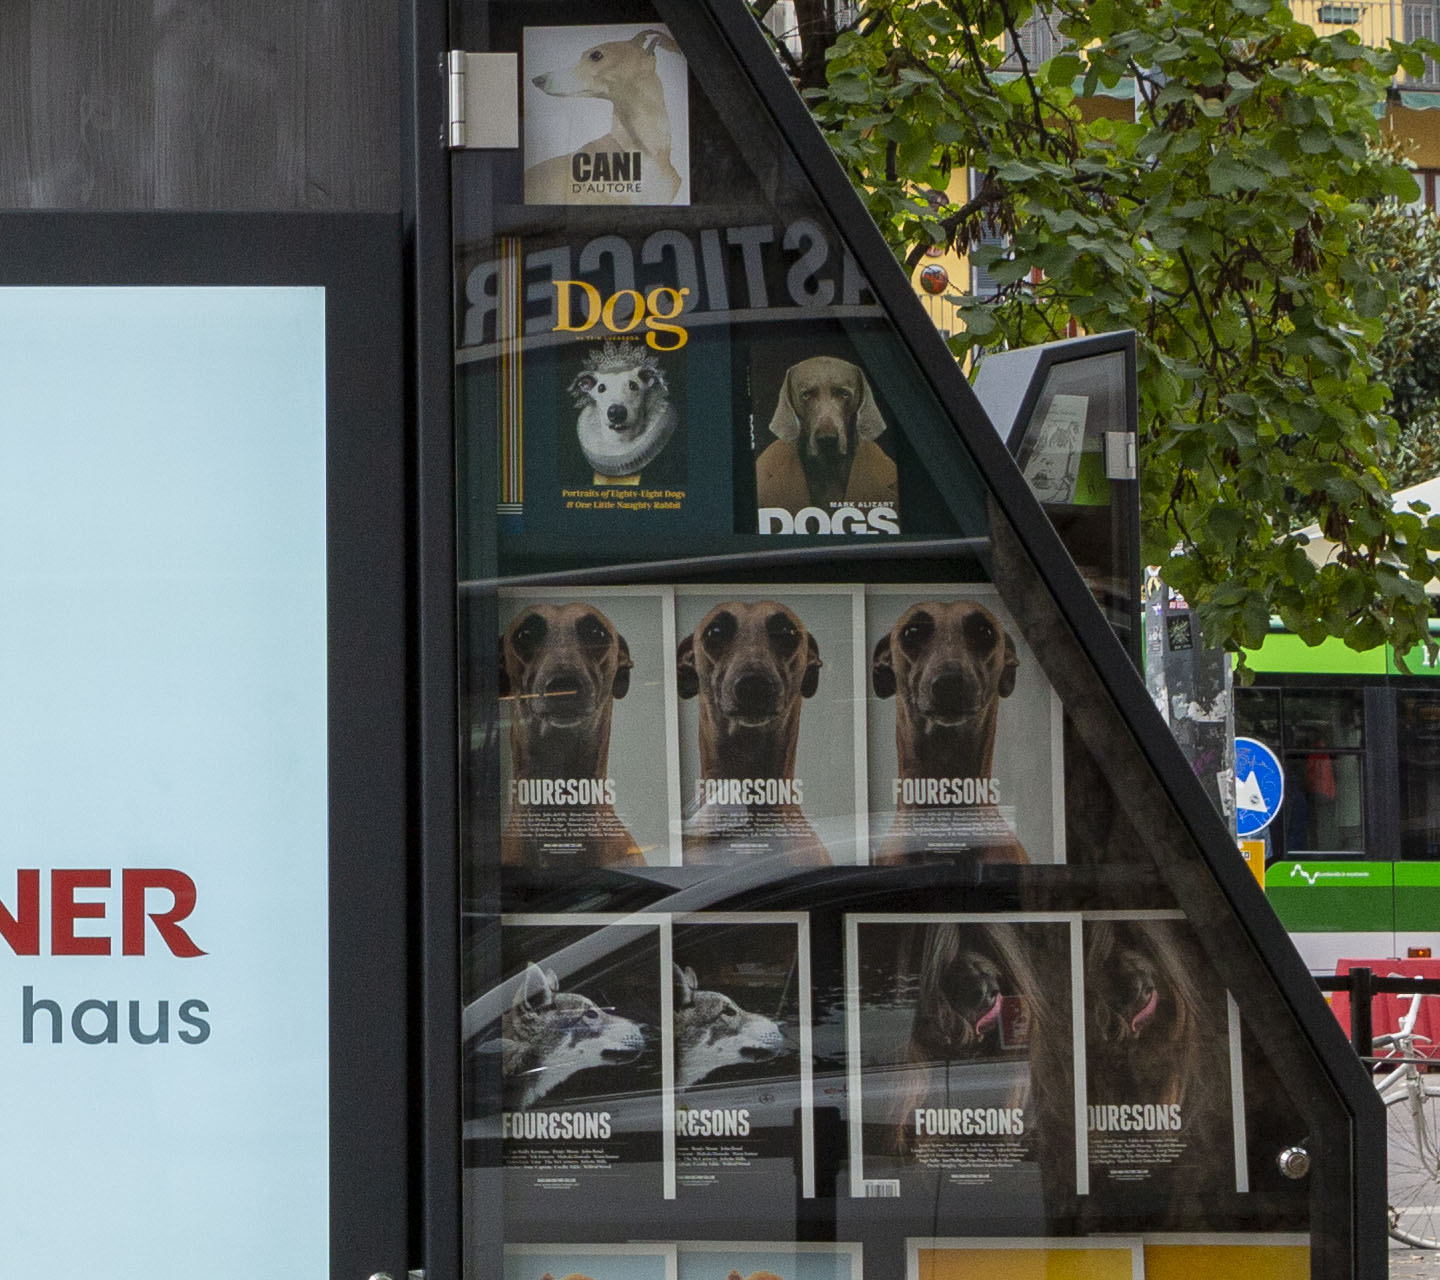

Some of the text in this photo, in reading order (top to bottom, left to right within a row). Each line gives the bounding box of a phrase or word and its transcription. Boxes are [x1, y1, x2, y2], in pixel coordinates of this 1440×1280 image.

[572, 151, 642, 183] CANI
[572, 182, 643, 194] D'AUTORE
[552, 279, 690, 351] Dog
[562, 489, 599, 498] Portraits
[601, 489, 610, 500] of
[664, 489, 686, 500] Dogs
[617, 501, 651, 511] Naughty
[758, 506, 901, 535] DOGS
[892, 777, 1001, 805] FOUR&SONS
[22, 985, 211, 1045] haus
[915, 1107, 1024, 1136] FOUR&SONS
